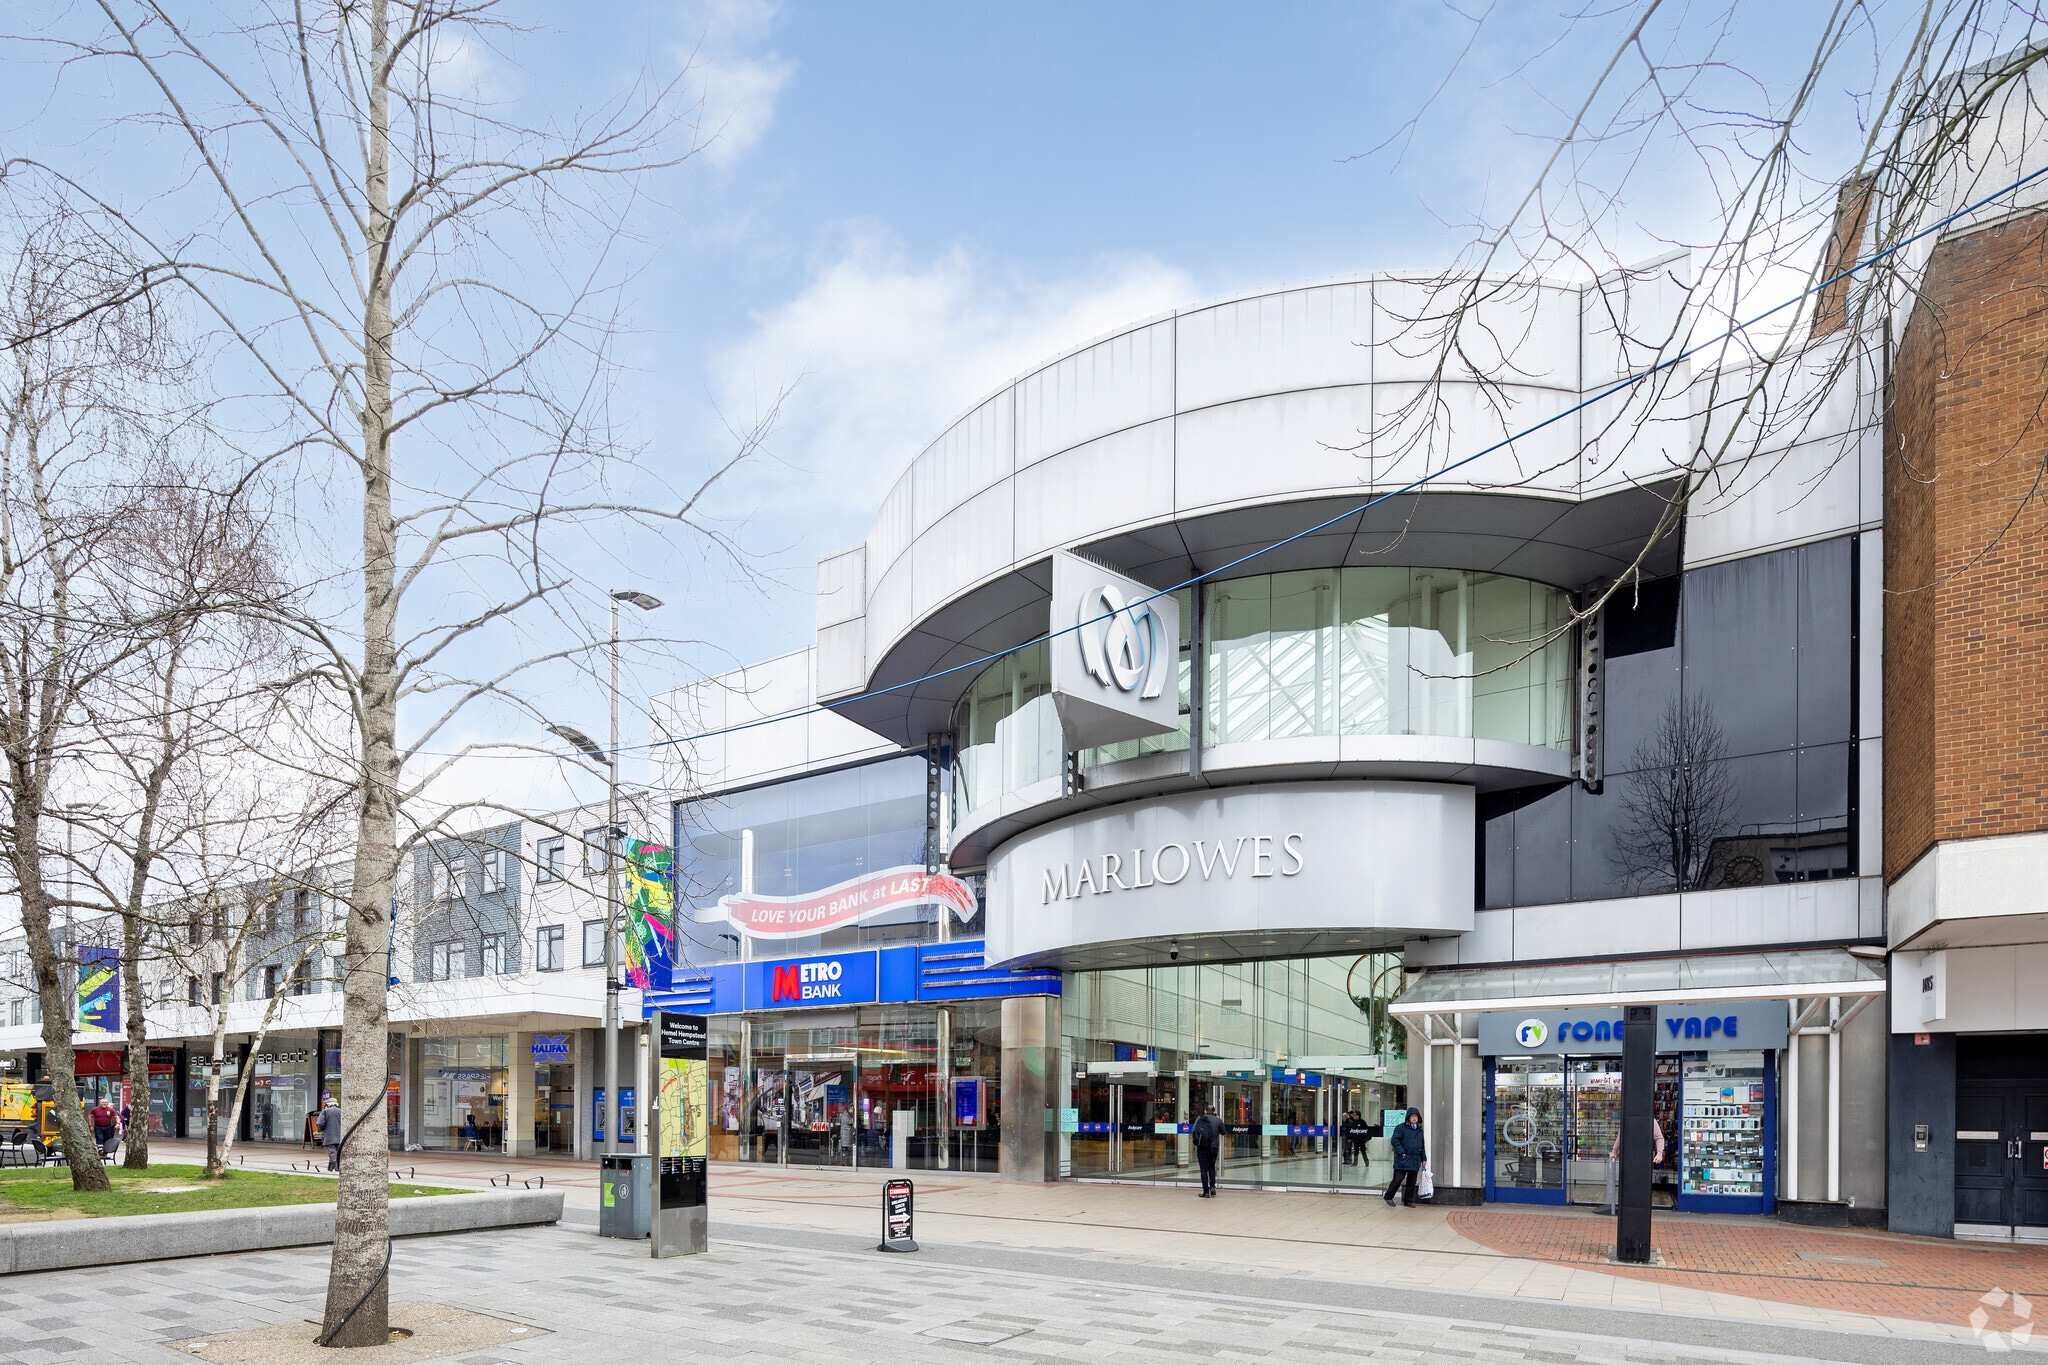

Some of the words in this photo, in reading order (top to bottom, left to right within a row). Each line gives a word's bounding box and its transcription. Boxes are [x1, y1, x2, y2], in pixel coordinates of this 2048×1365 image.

[1041, 833, 1304, 905] MARLOWES
[751, 909, 785, 924] LOVE
[787, 907, 826, 923] YOUR
[830, 891, 867, 917] BANK
[872, 885, 887, 900] at
[890, 878, 932, 896] LAST
[772, 961, 842, 1001] METRO
[802, 983, 842, 1000] BANK
[669, 1021, 692, 1030] Welcome
[1558, 1020, 1624, 1042] FONE
[1665, 1016, 1738, 1039] VAPE
[668, 1037, 682, 1045] Town
[678, 1030, 706, 1039] Hempstead
[531, 1044, 569, 1054] HALIFAX
